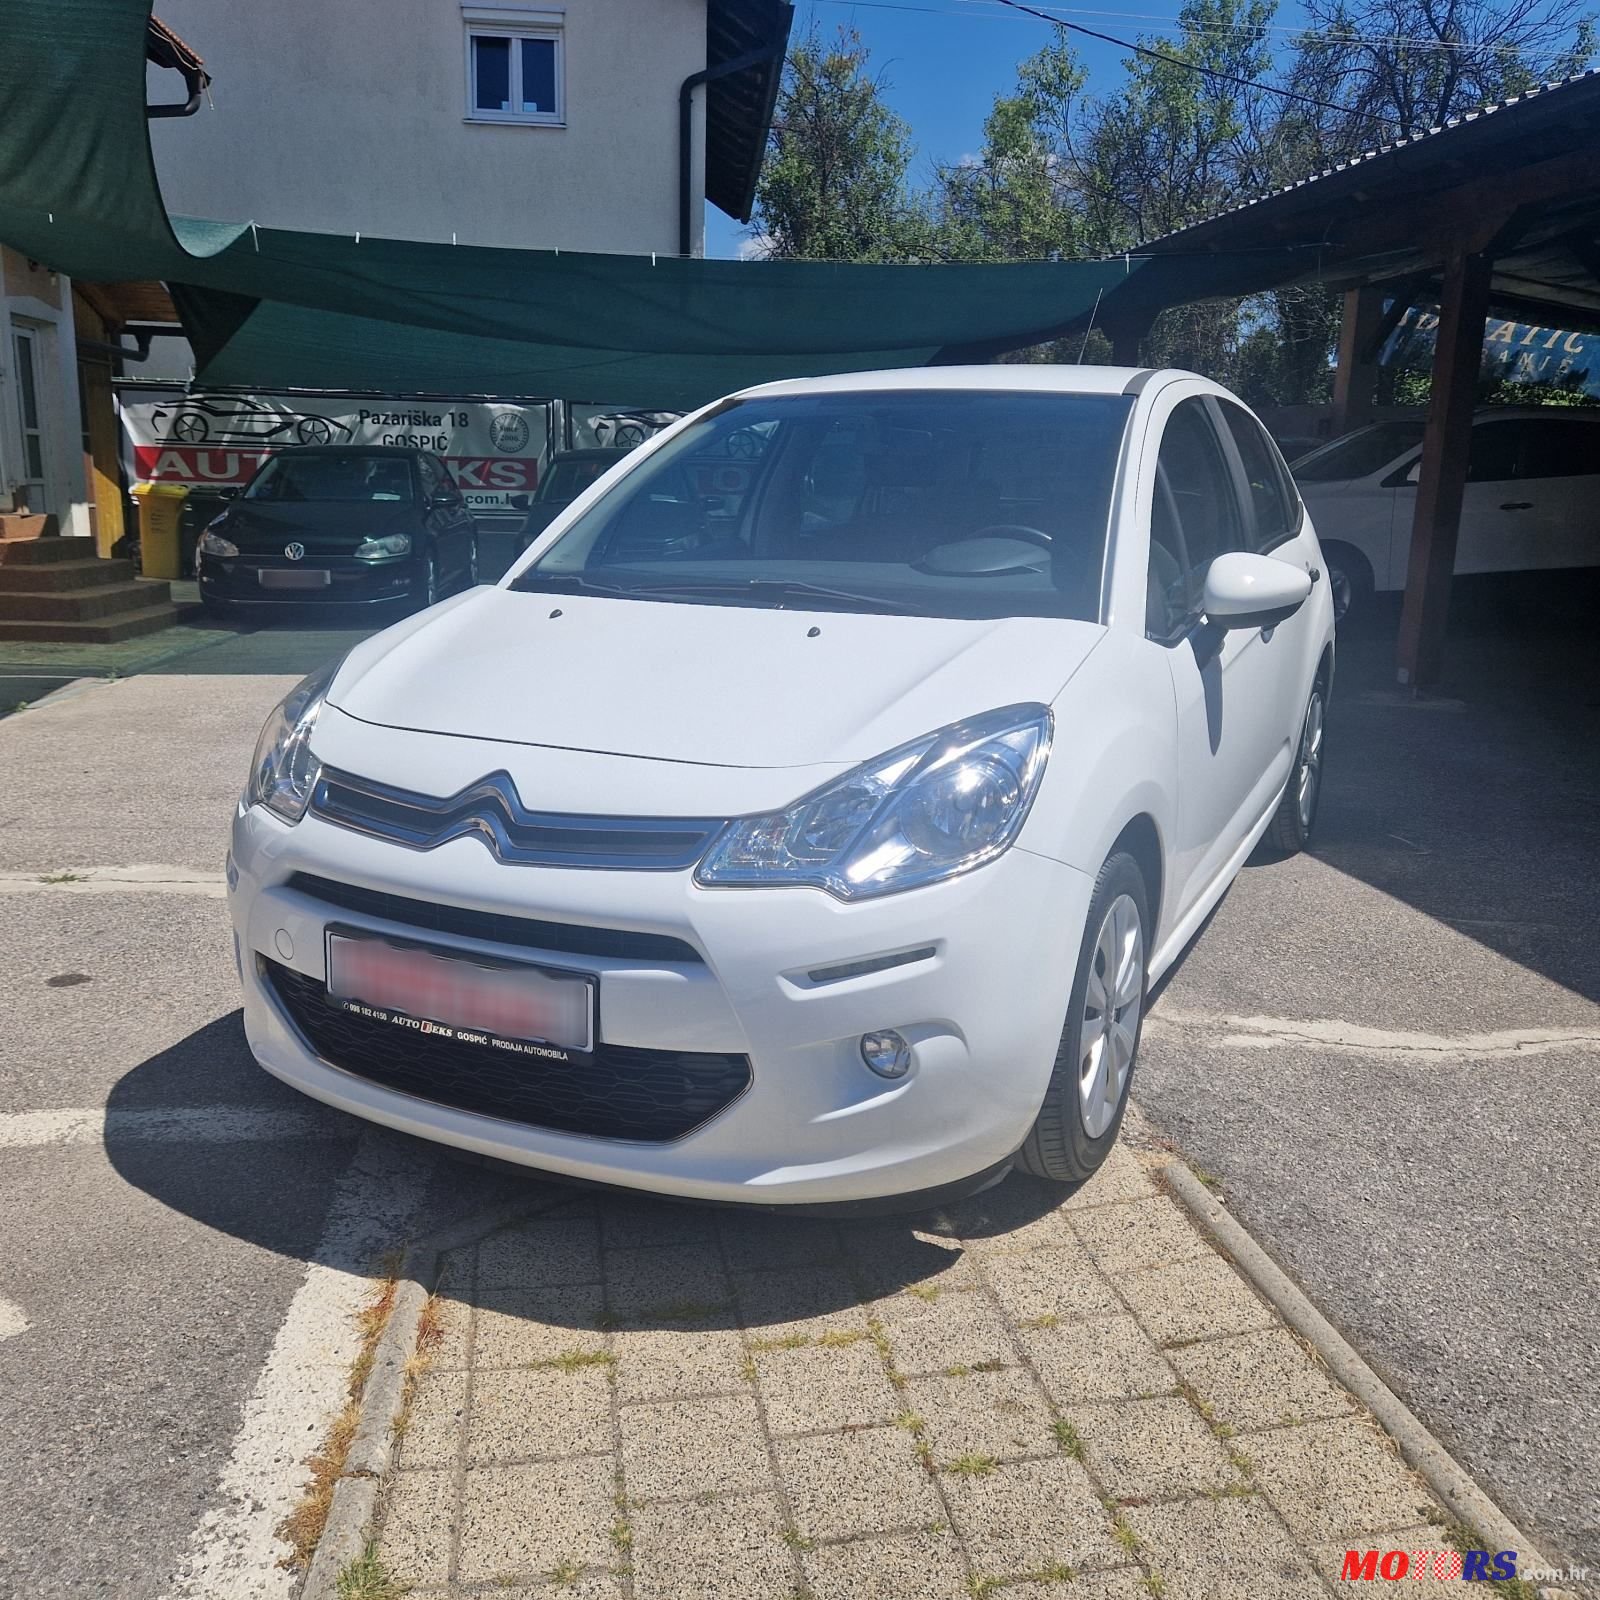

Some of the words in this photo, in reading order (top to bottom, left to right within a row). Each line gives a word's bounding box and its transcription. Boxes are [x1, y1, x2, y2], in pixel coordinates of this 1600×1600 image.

[359, 409, 442, 428] Pazariška
[450, 412, 469, 428] 18
[382, 432, 448, 451] GOSPIĆ
[373, 1010, 387, 1021] 4150
[392, 1015, 420, 1029] AUTO
[457, 1031, 488, 1045] GOSPIĆ
[492, 1039, 523, 1053] PRODAJA
[523, 1045, 568, 1061] AUTOMOBILA
